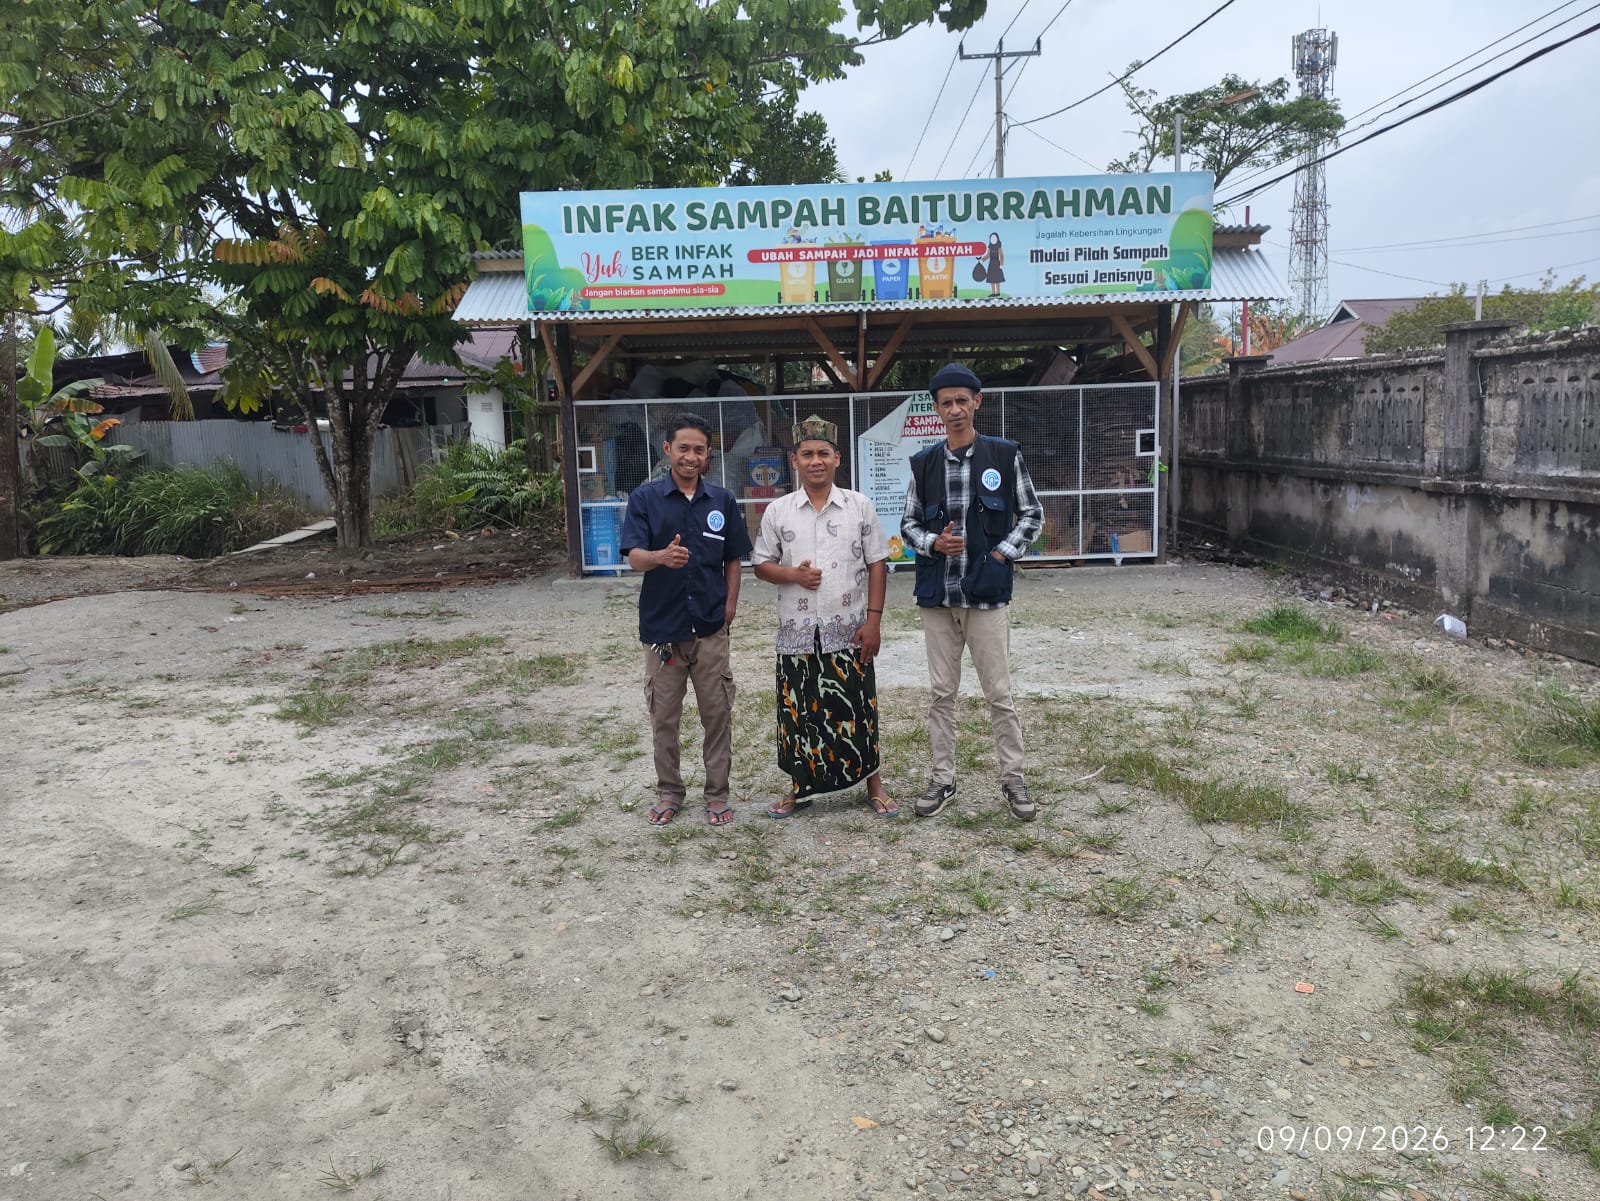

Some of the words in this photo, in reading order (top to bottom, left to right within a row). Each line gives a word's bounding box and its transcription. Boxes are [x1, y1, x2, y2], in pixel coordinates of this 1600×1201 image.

[563, 203, 677, 233] INFAK
[686, 198, 845, 231] SAMPAH
[857, 185, 1172, 226] BAITURRAHMAN
[1035, 231, 1067, 240] Jagalah
[1069, 229, 1114, 238] Kebersihan
[1116, 227, 1162, 238] Lingkungan
[631, 246, 669, 261] BER
[675, 243, 733, 260] INFAK
[761, 251, 793, 261] UBAH
[799, 249, 847, 260] SAMPAH
[852, 248, 878, 259] JADI
[884, 247, 919, 258] INFAK
[924, 245, 973, 256] JARIYAH
[1029, 248, 1070, 263] Mulai
[1074, 246, 1108, 261] Pilah
[1113, 244, 1168, 262] Sampah
[580, 249, 628, 284] Yuk
[633, 263, 734, 281] SAMPAH
[1044, 270, 1088, 285] Sesuai
[1092, 268, 1153, 285] Jenisnya
[585, 288, 613, 299] Jangan
[615, 286, 645, 296] biarkan
[647, 285, 691, 297] sampahmu
[692, 285, 719, 294] sia-sia
[918, 393, 933, 401] SA
[908, 403, 935, 413] ITER
[914, 415, 944, 427] SAMPA
[903, 425, 947, 437] RRAHMAN
